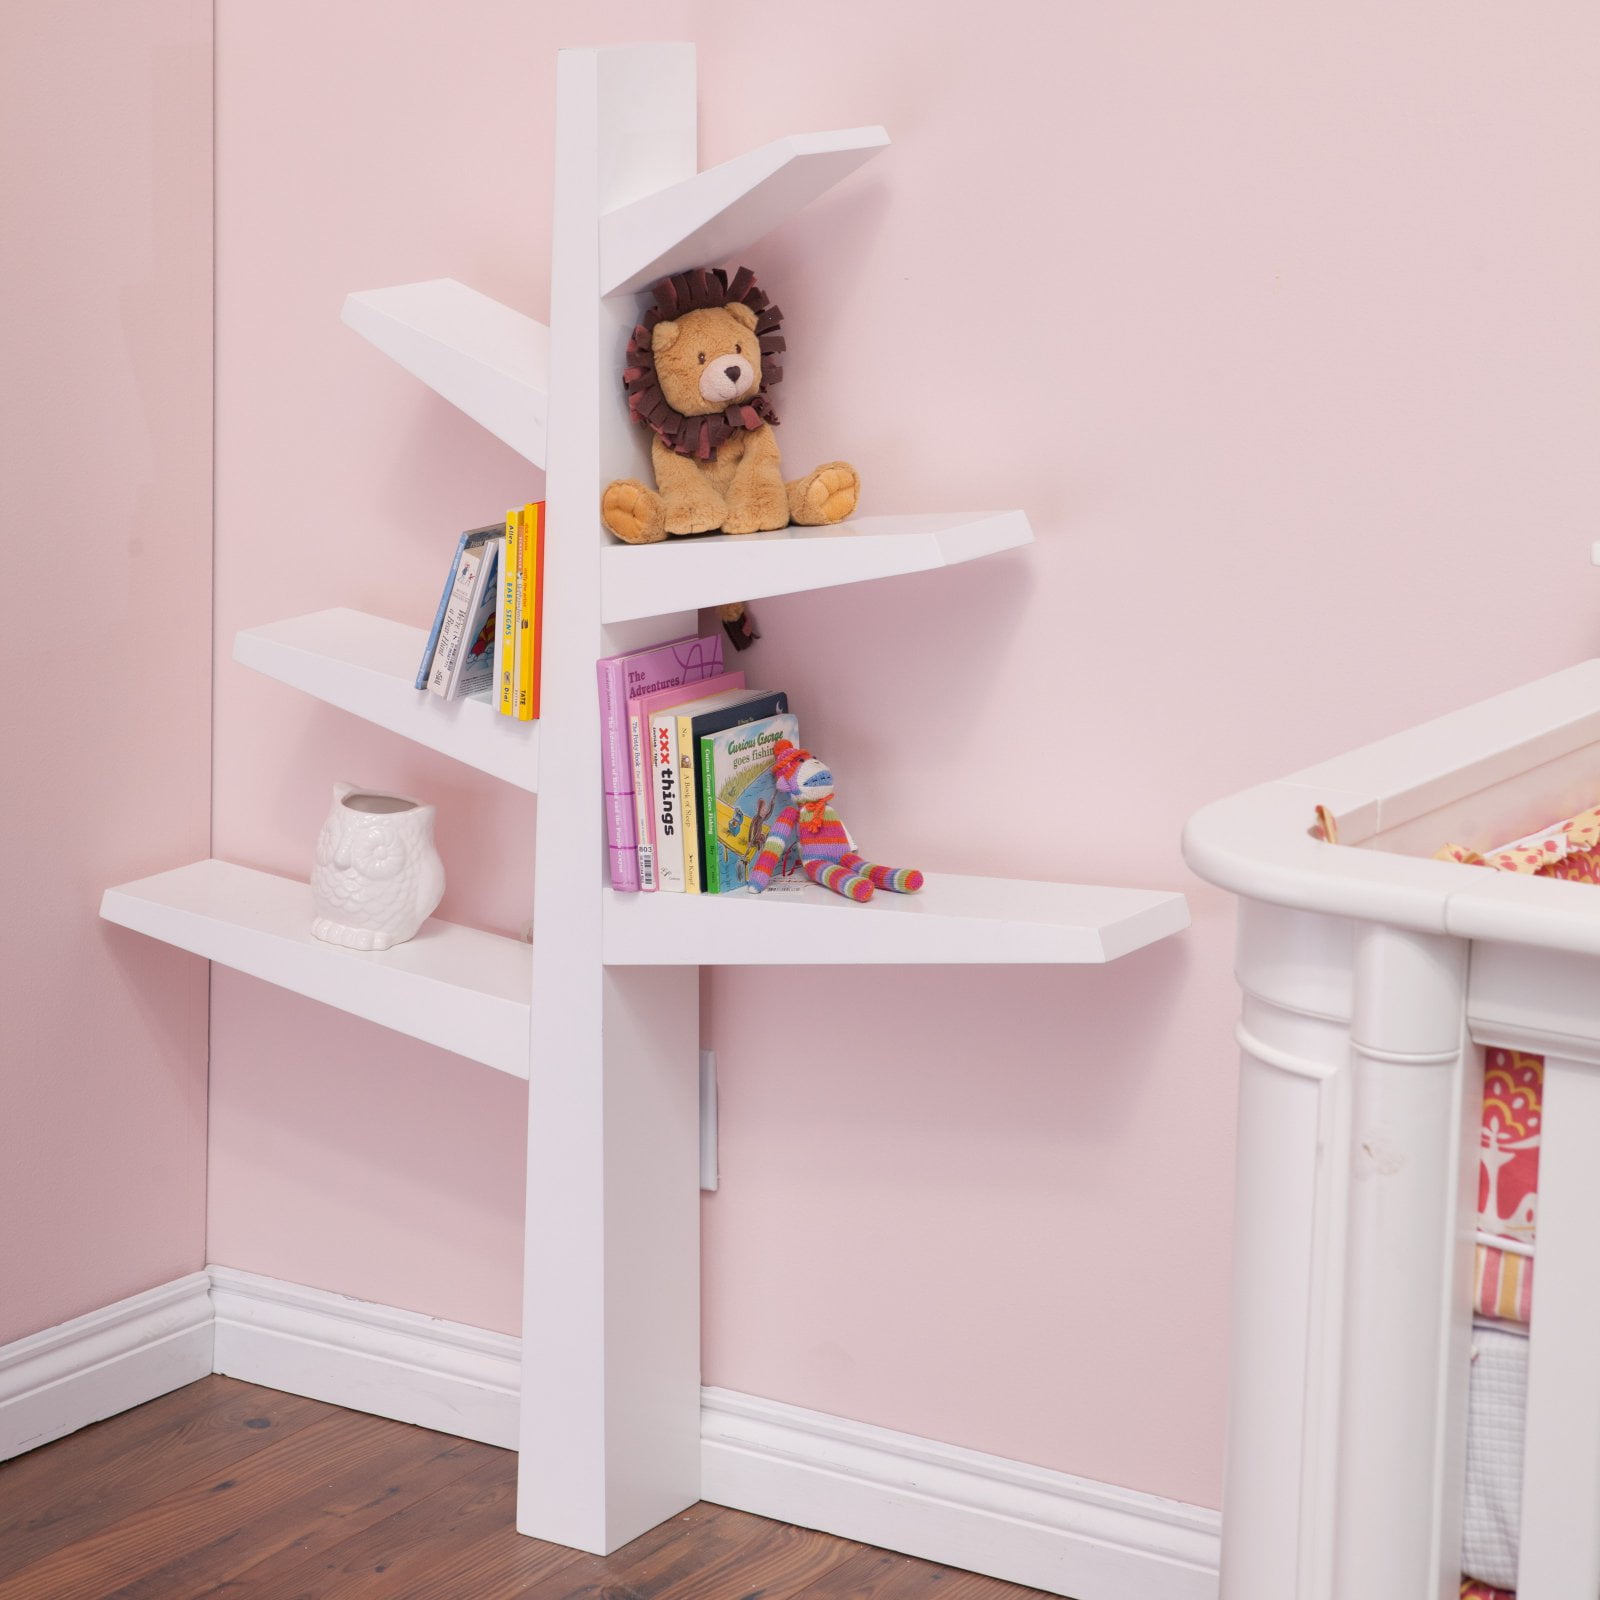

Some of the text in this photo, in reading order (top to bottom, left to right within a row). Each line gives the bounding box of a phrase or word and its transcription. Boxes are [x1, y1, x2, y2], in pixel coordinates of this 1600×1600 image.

[444, 615, 454, 635] Bear
[628, 670, 646, 684] The
[629, 676, 680, 699] Adventures
[728, 730, 784, 755] Curious George
[733, 745, 776, 769] goes fishin
[661, 768, 676, 836] things
